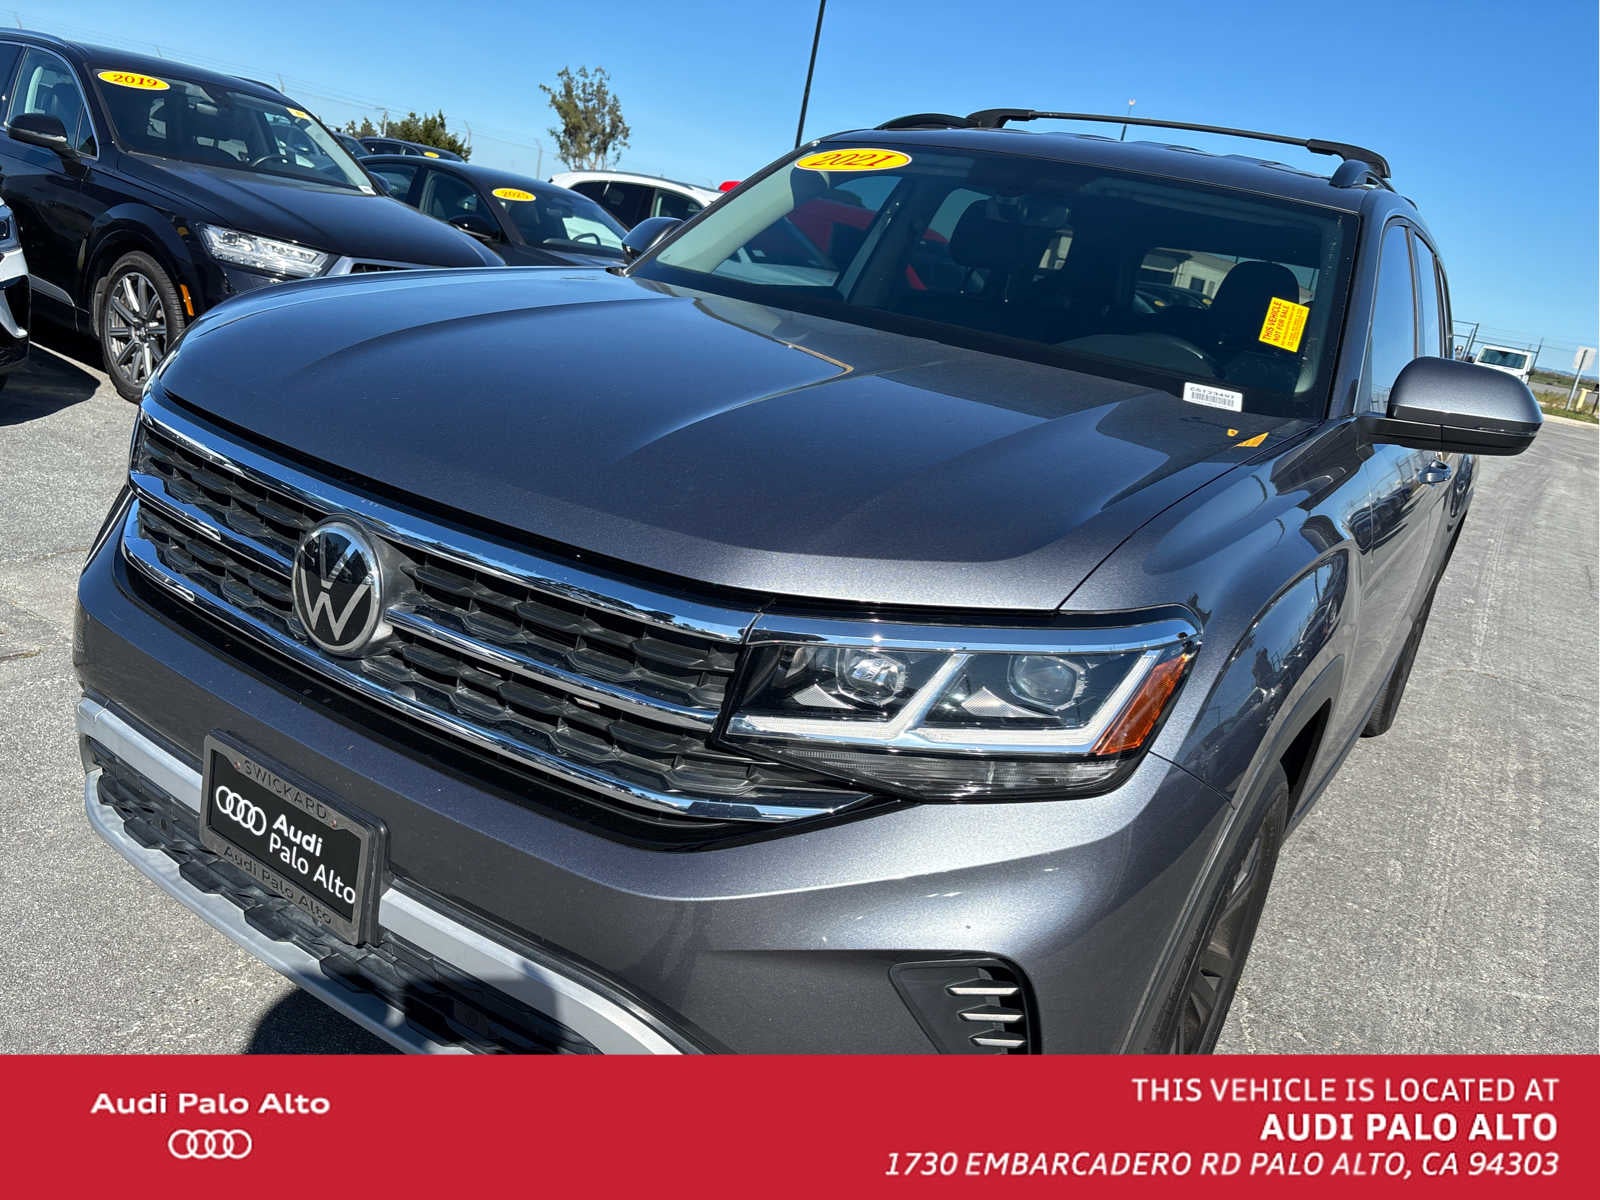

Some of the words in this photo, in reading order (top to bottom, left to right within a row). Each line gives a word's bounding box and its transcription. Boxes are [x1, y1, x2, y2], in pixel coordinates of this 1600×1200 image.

[113, 74, 158, 87] 2019
[808, 153, 896, 167] 2021
[1267, 301, 1281, 327] VEHICLE
[1279, 304, 1289, 318] SALE
[1276, 318, 1285, 330] FOR
[1262, 325, 1273, 341] THIS
[1272, 330, 1281, 342] NOT
[244, 760, 328, 820] SWICKARD
[272, 813, 323, 857] Audi
[269, 833, 309, 875] Palo
[313, 864, 356, 905] Alto
[223, 846, 257, 874] Audi
[262, 871, 295, 899] Palo
[299, 895, 332, 924] Alto
